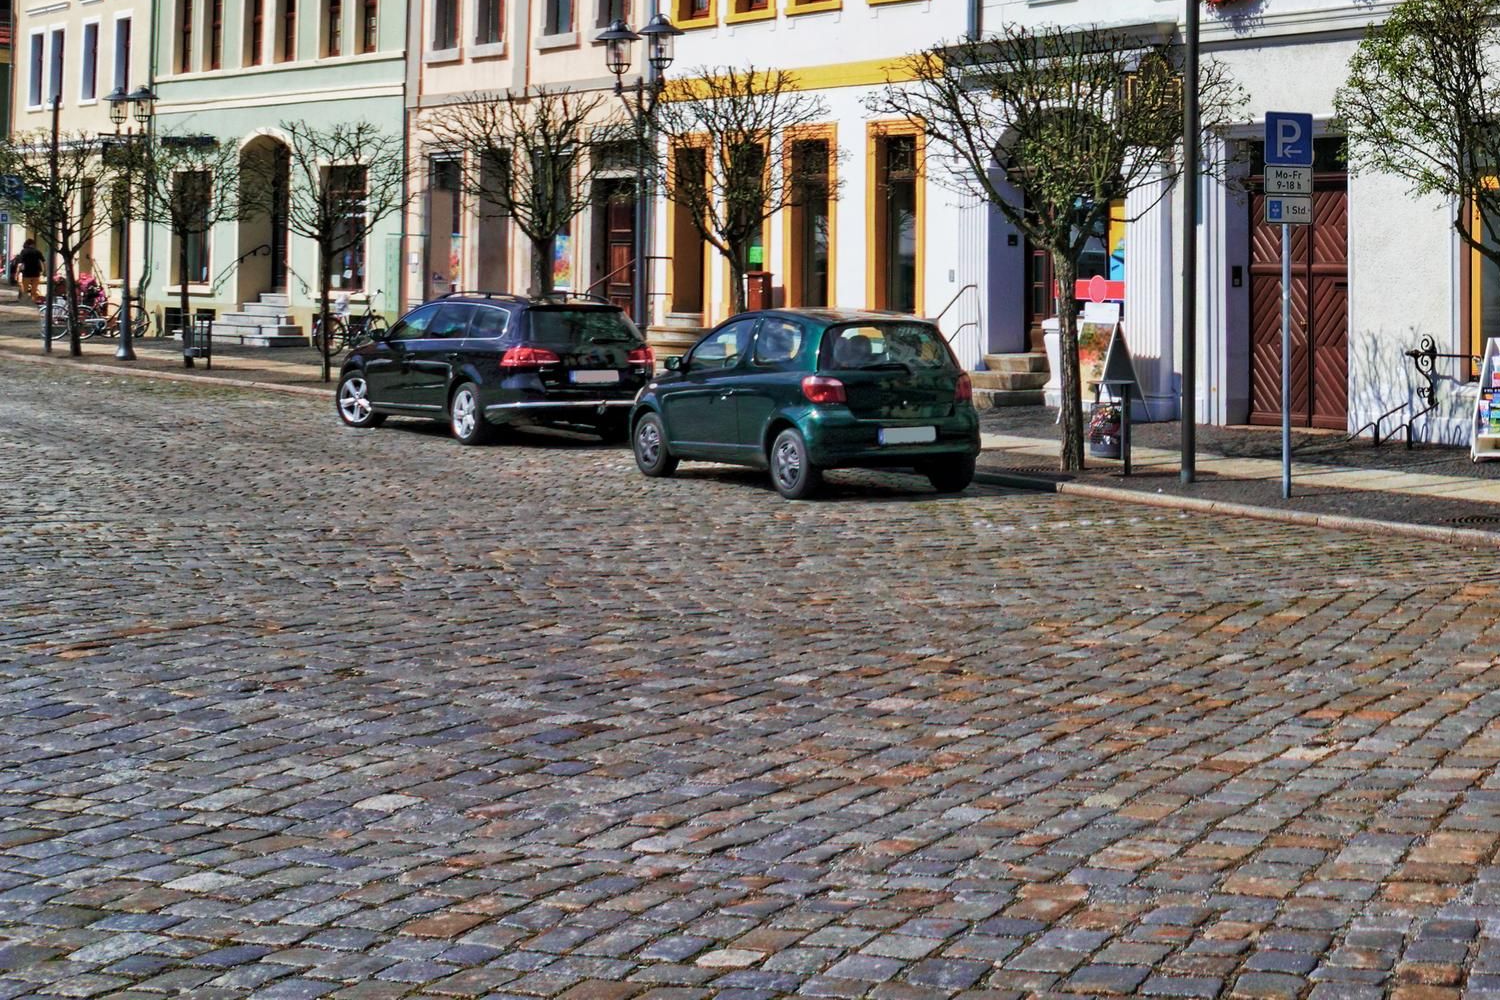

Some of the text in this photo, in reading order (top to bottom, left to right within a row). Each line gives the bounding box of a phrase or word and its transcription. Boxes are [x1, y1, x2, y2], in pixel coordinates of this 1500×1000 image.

[1276, 119, 1302, 158] P
[1275, 170, 1303, 179] Mo-Fr
[1276, 180, 1302, 190] 9-18 h
[1286, 205, 1290, 214] 1
